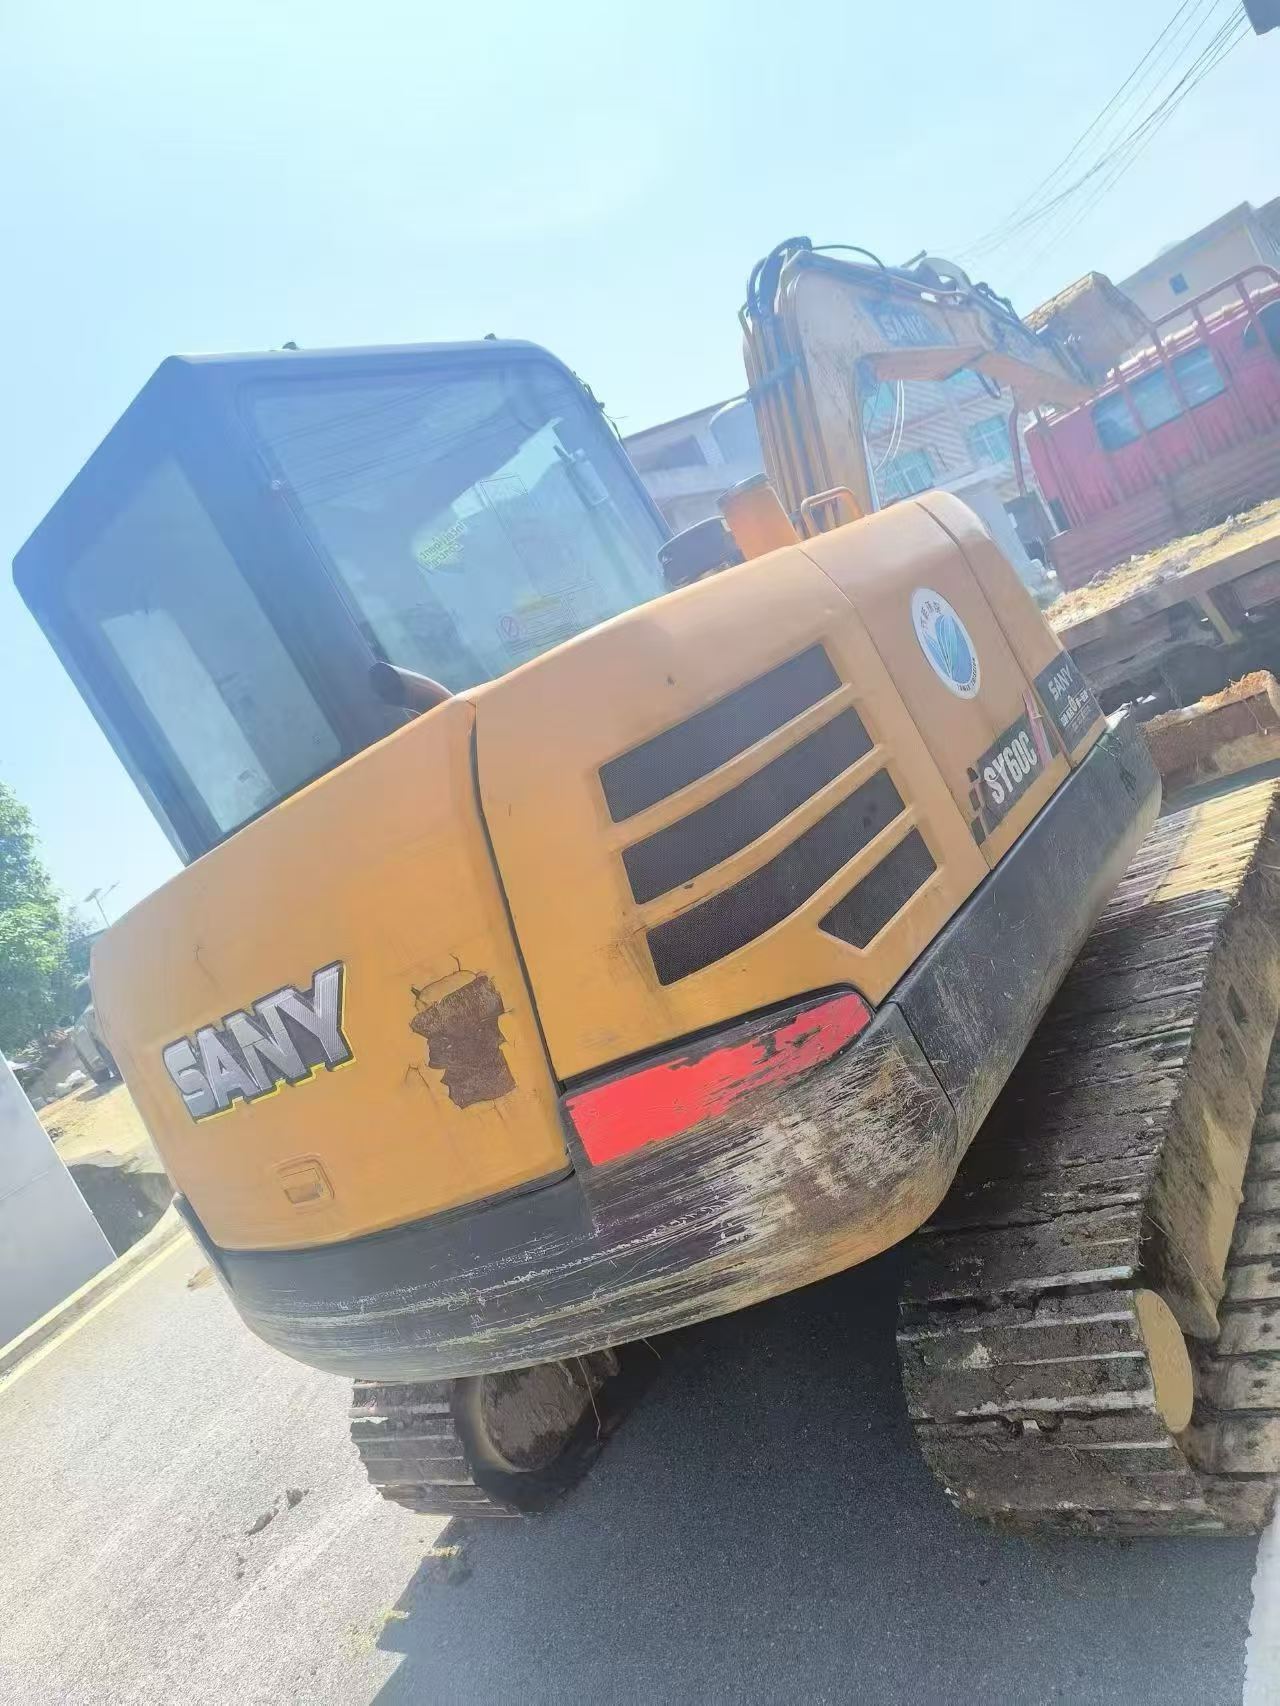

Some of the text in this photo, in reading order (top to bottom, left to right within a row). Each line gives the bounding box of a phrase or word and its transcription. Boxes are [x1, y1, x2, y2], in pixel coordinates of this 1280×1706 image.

[1048, 664, 1073, 701] SANY
[983, 730, 1038, 804] SY60C
[163, 960, 355, 1123] SANY
